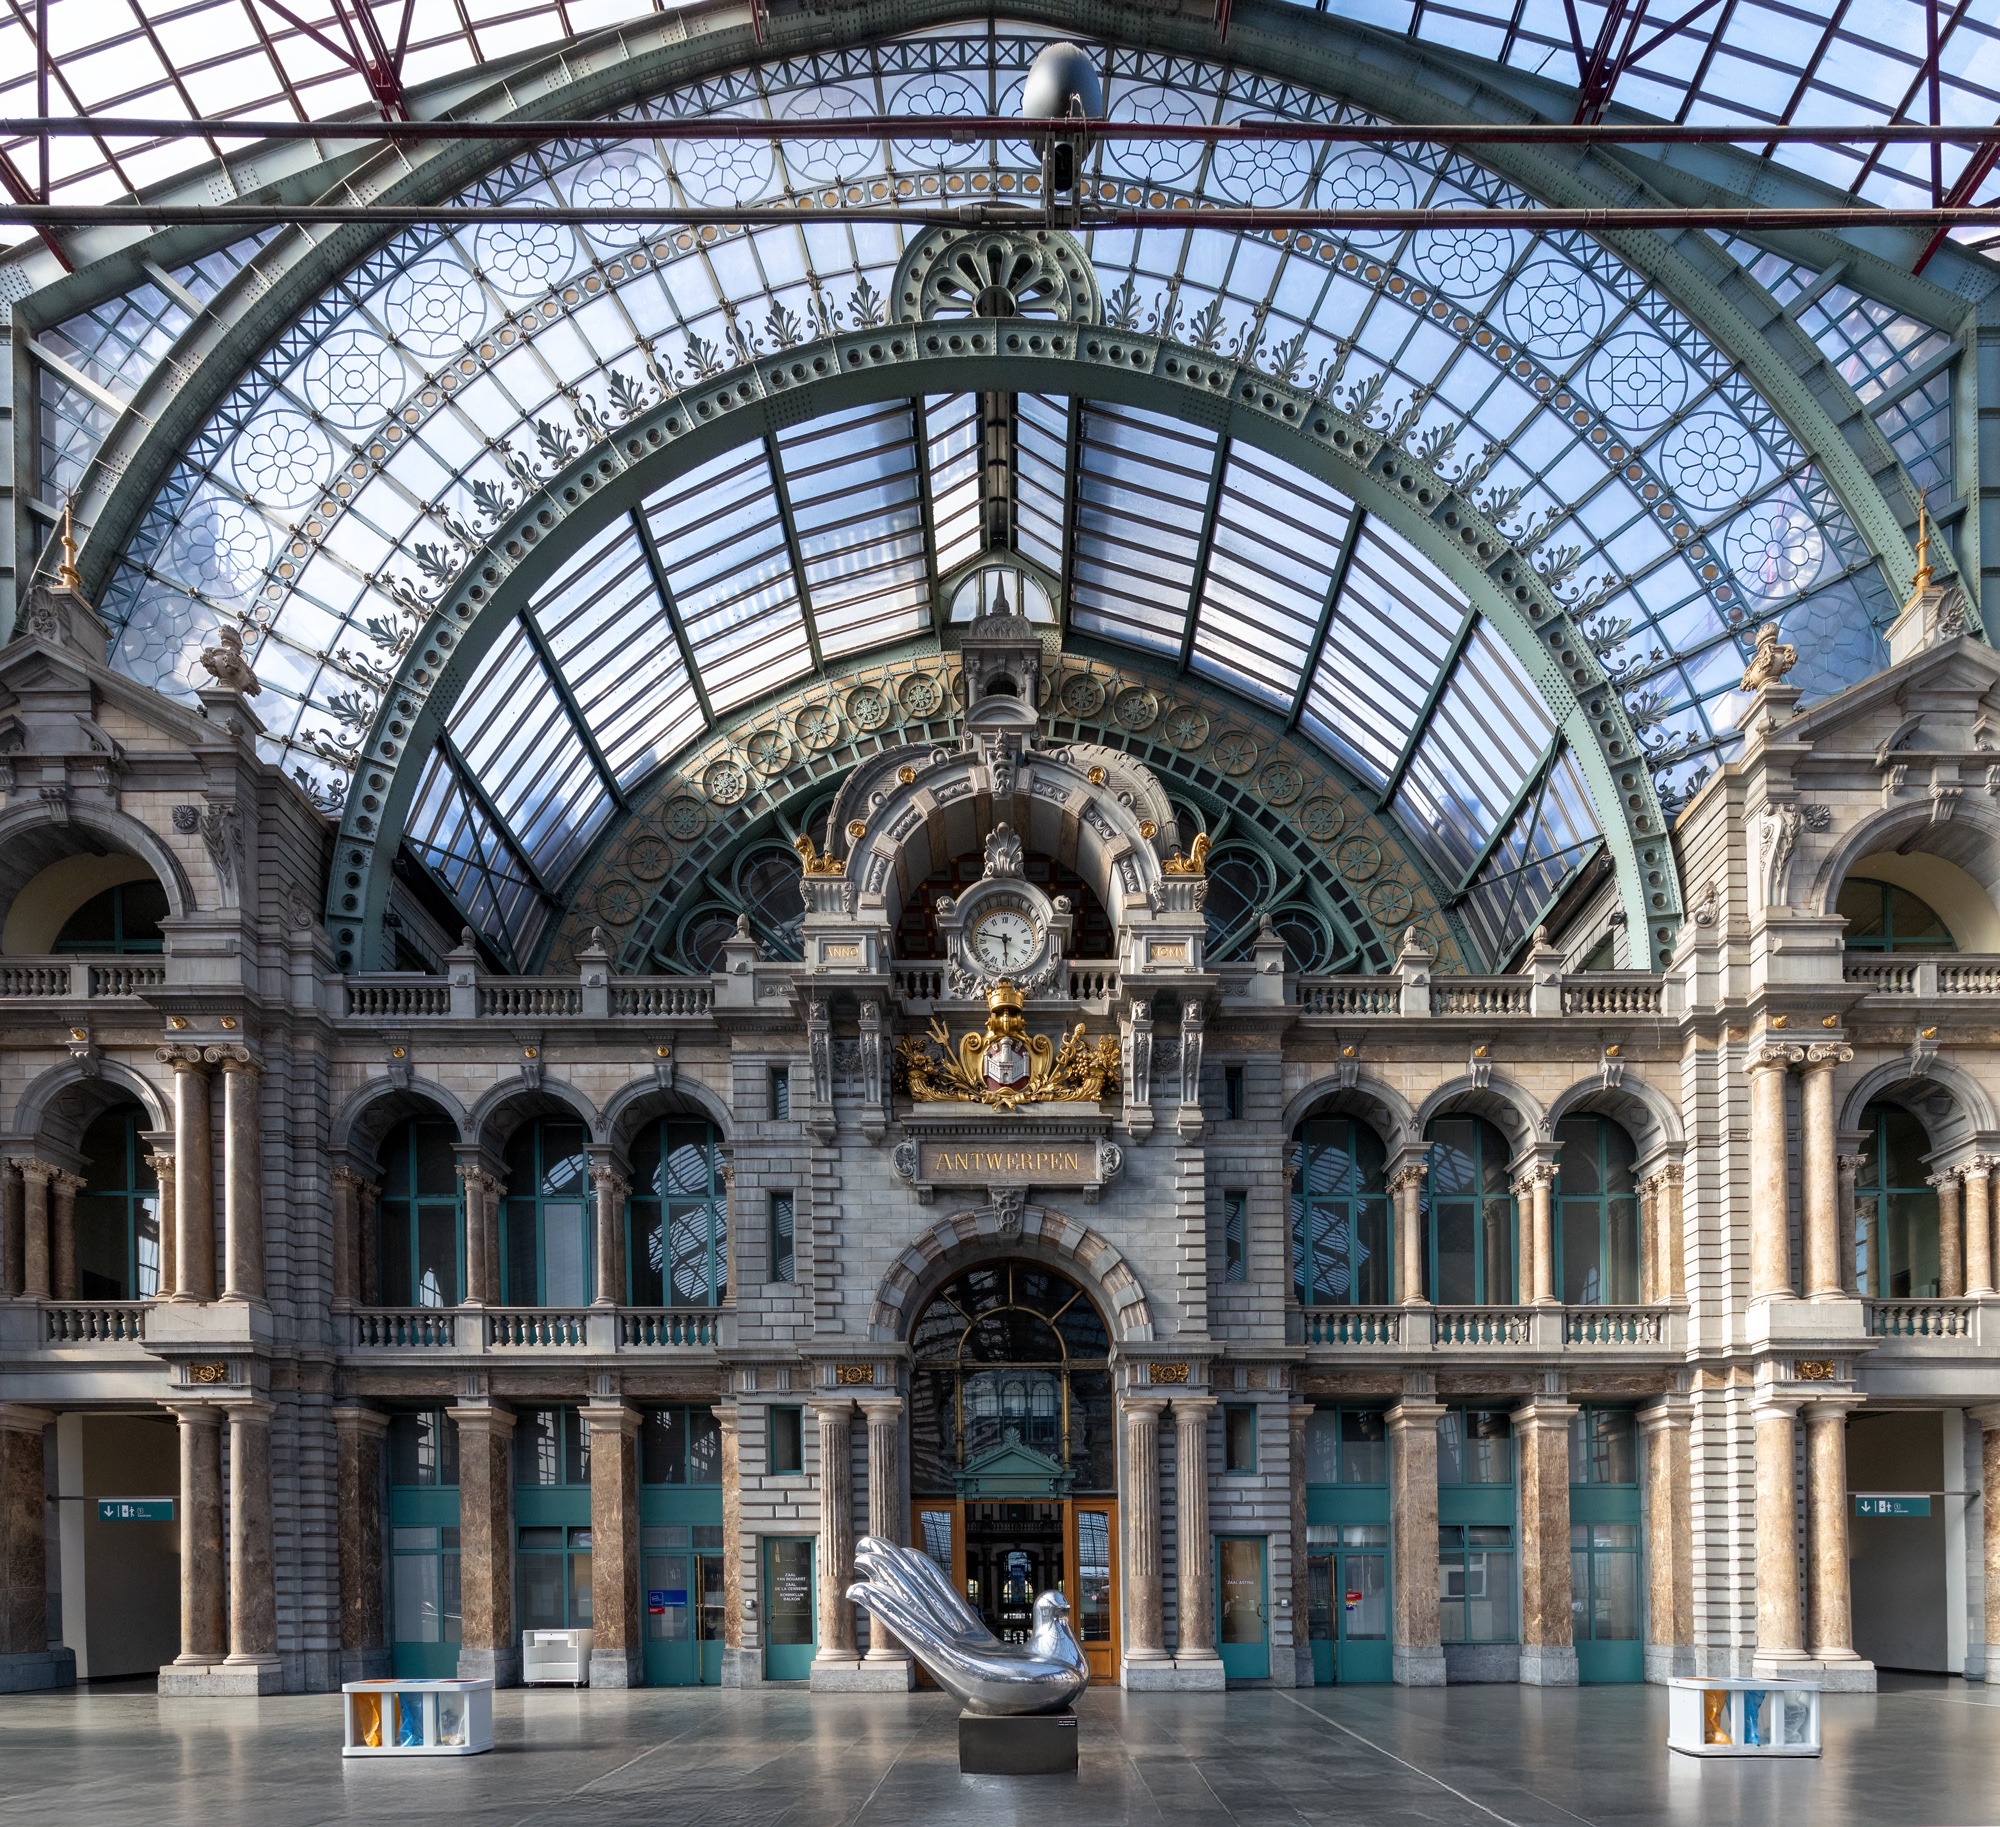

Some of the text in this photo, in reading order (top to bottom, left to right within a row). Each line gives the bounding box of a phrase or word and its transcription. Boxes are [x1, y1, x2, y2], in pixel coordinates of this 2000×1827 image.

[827, 947, 858, 956] ANNO
[1151, 947, 1185, 957] MCMV
[935, 1152, 1079, 1170] ANTWERPEN
